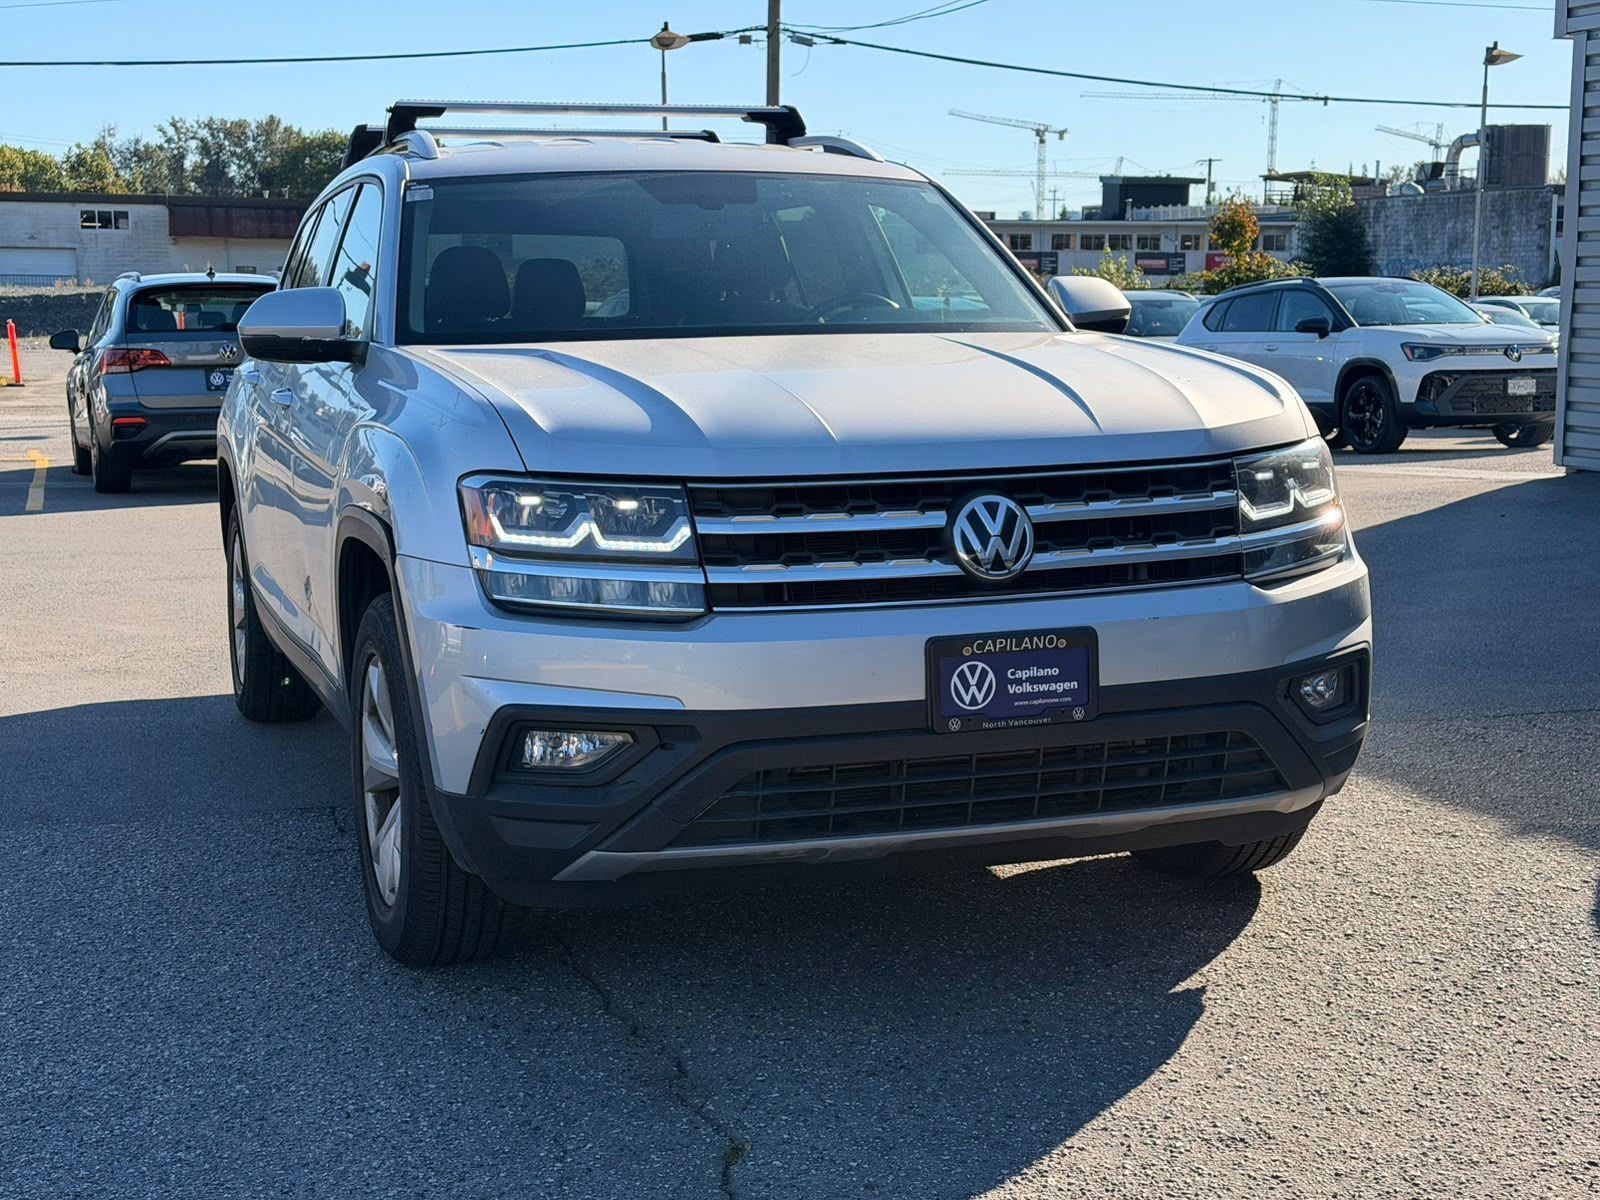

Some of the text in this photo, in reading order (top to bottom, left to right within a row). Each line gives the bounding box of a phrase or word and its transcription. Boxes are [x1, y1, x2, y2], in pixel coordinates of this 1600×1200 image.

[953, 495, 1034, 580] VW
[973, 635, 1057, 653] CAPILANO
[1007, 666, 1059, 680] Capilano
[951, 661, 995, 709] VW
[1007, 681, 1078, 694] Volkswagen
[982, 717, 1052, 729] North Vancouver
